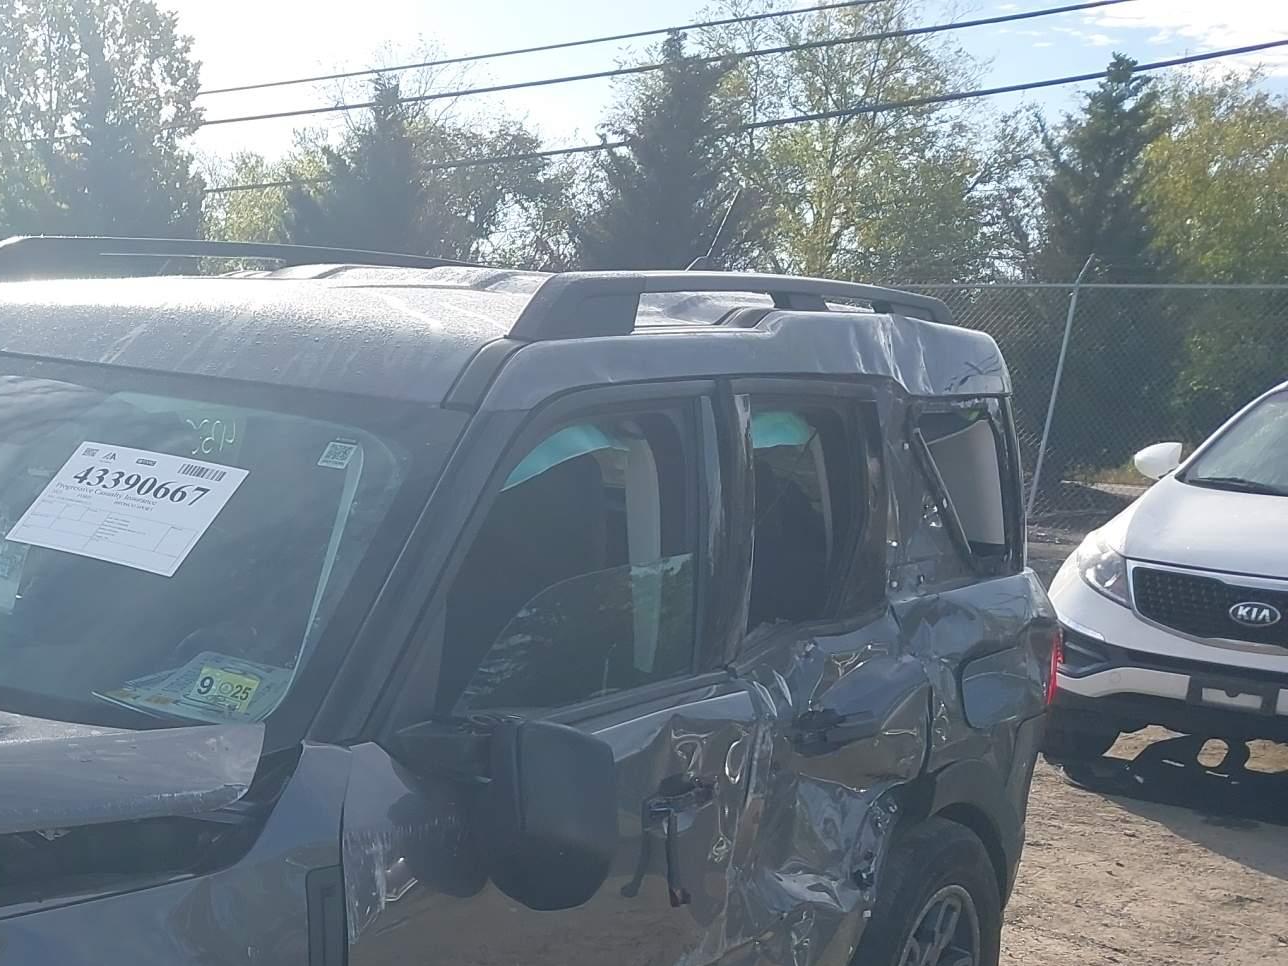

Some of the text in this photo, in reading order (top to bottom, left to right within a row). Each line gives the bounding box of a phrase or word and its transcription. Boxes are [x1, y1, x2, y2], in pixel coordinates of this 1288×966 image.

[73, 466, 211, 507] 43390667
[1237, 605, 1272, 623] KIA
[197, 676, 252, 701] 9 25
